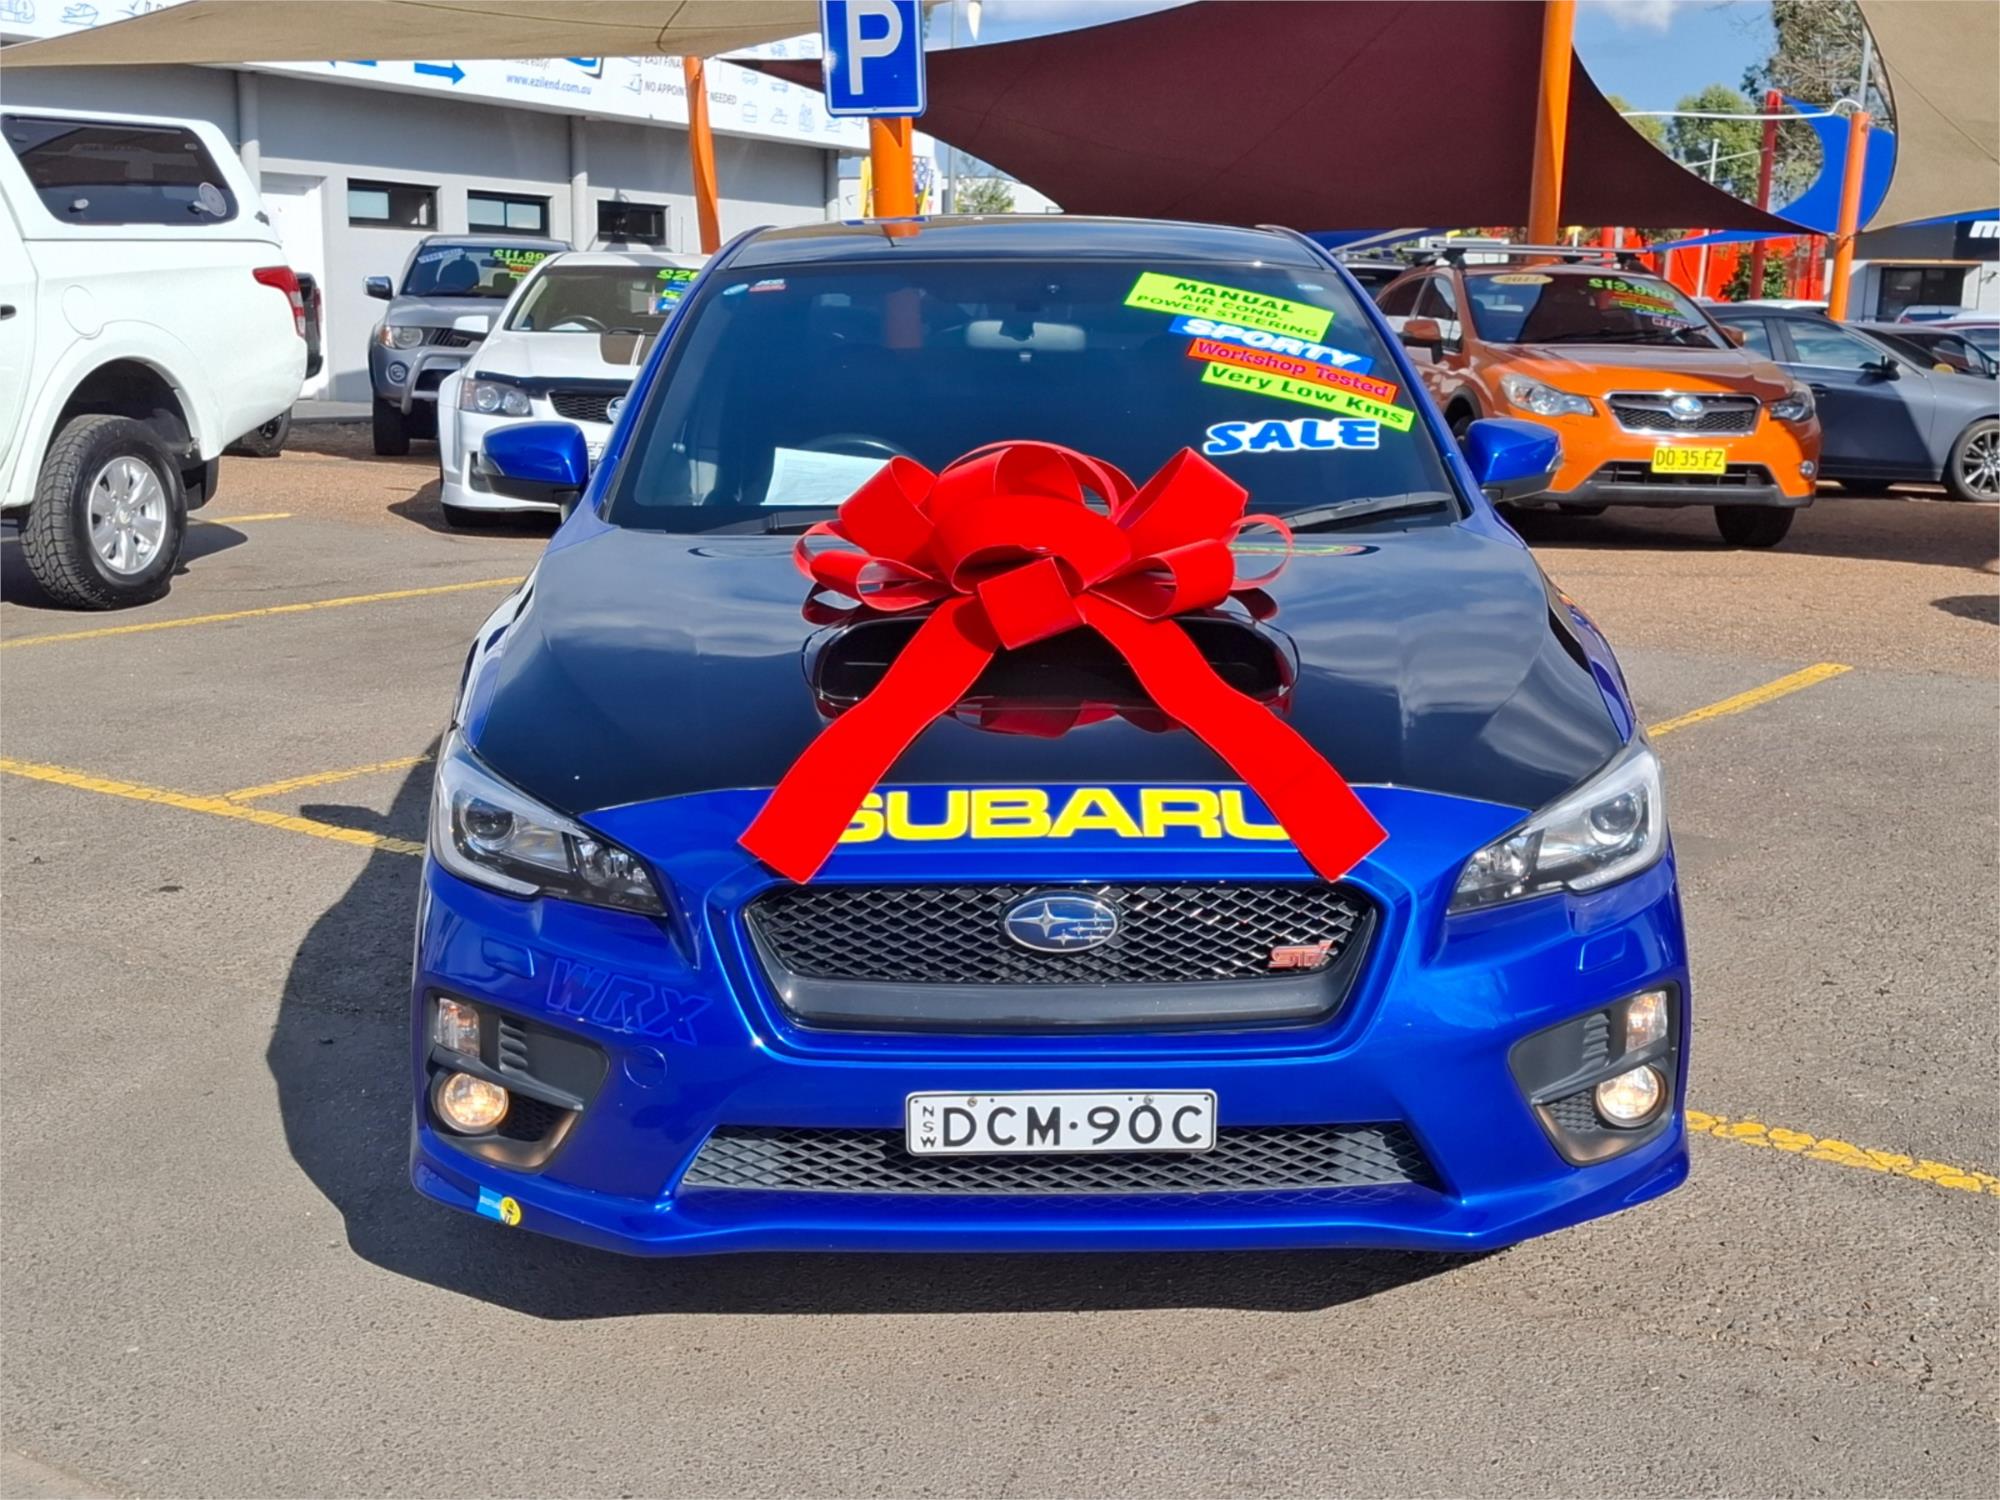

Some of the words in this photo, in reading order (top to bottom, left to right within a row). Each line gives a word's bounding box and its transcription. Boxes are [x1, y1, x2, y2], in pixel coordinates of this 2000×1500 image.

[846, 0, 903, 95] P
[1136, 295, 1208, 314] POWER
[1215, 309, 1318, 337] STEERING
[1174, 282, 1294, 314] MANUAL
[1180, 294, 1214, 306] AIR
[1222, 301, 1282, 321] COND.
[1182, 319, 1362, 368] SPORTY
[1198, 341, 1307, 376] Workshop
[1315, 365, 1389, 397] Tested
[1211, 365, 1272, 390] Very
[1280, 380, 1337, 403] Low
[1345, 396, 1405, 424] Kms
[1203, 418, 1380, 455] SALE
[546, 958, 713, 1045] WRX
